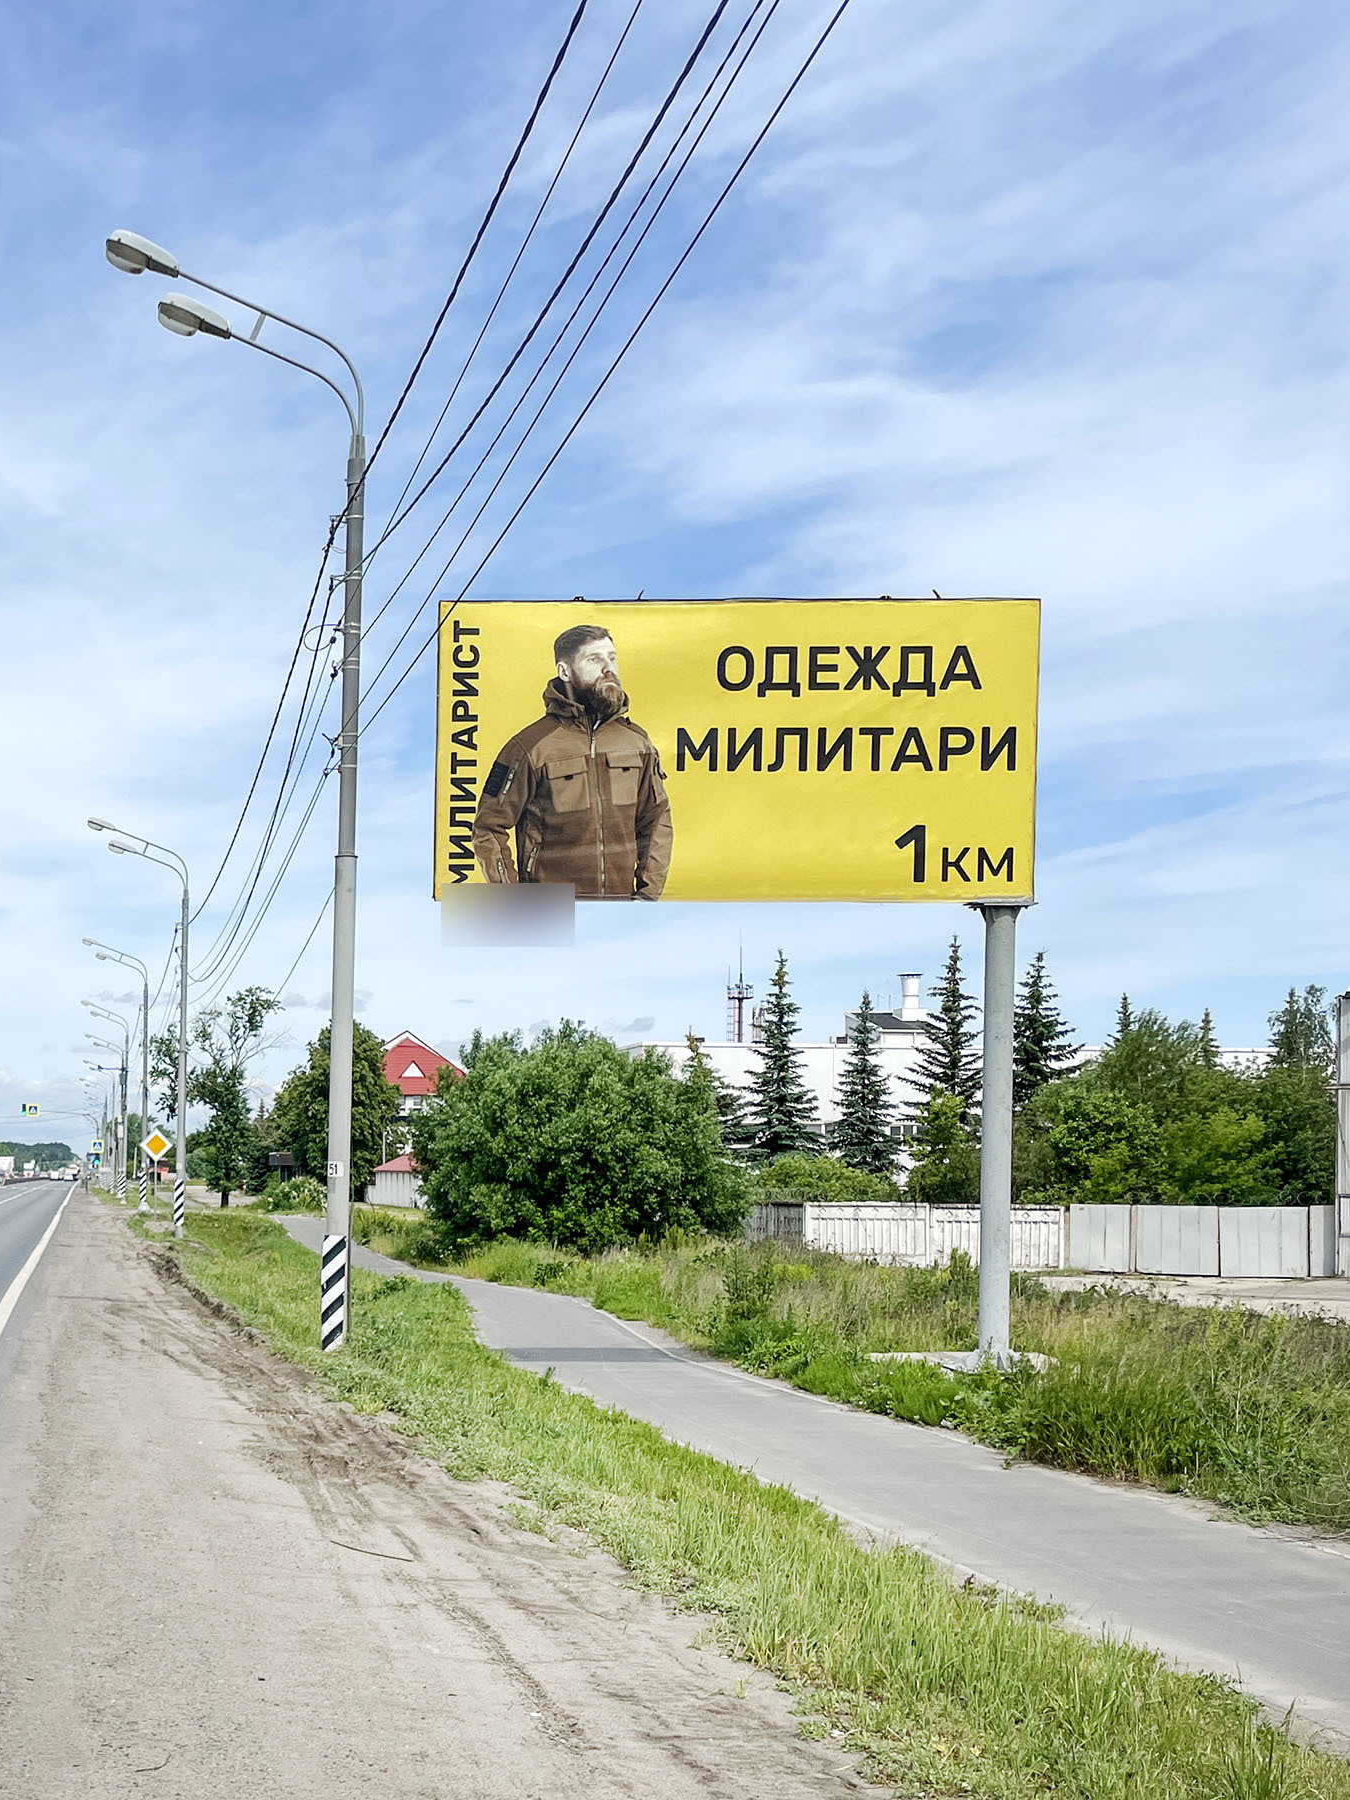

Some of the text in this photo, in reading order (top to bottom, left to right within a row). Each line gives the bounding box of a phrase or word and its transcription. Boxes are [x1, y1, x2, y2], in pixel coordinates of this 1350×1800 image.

[716, 645, 983, 698] ОДЕЖДА
[448, 620, 481, 883] МИЛИТАРИСТ
[676, 726, 1018, 773] МИЛИТАРИ
